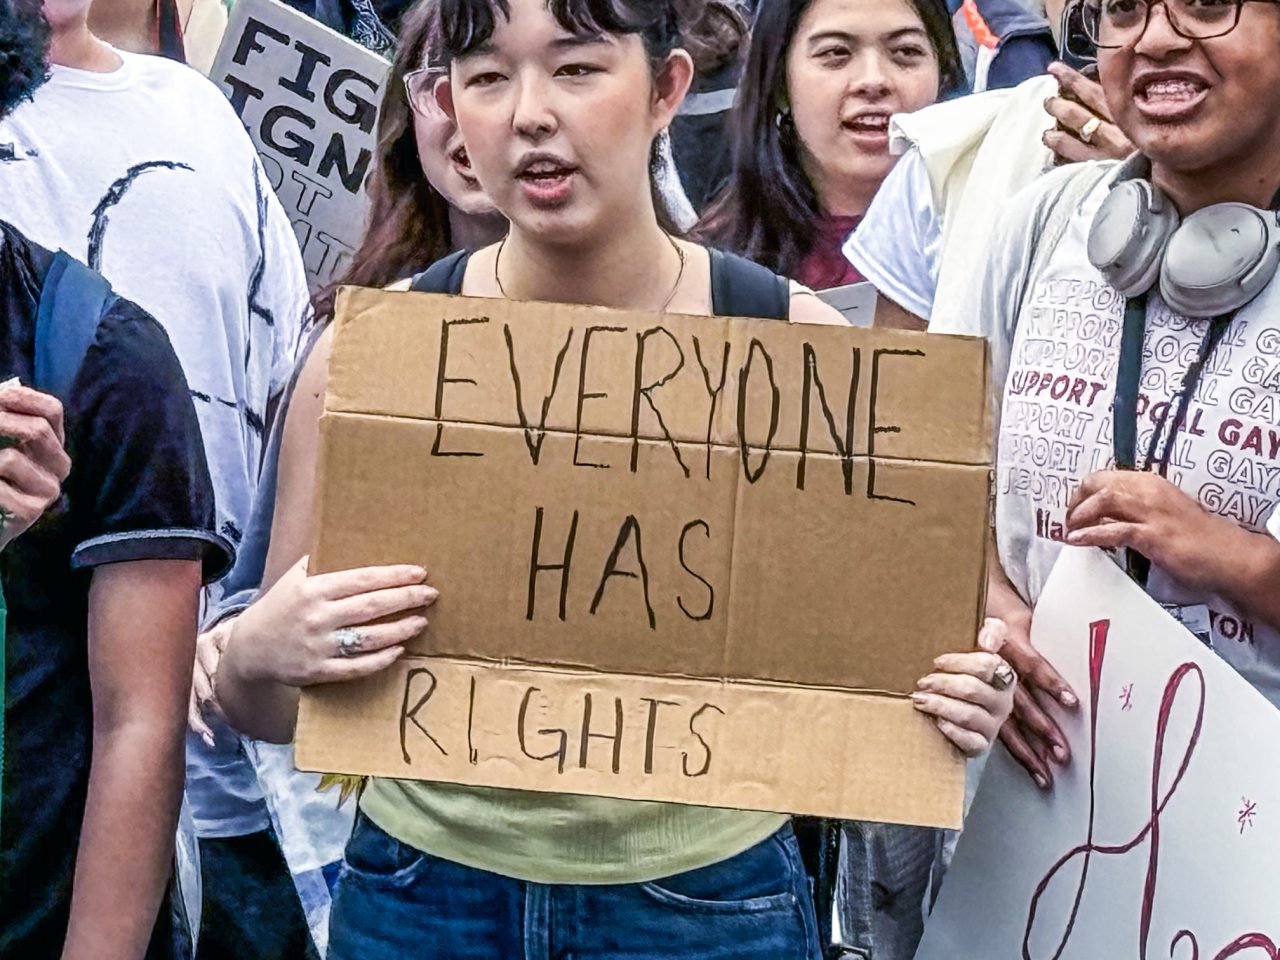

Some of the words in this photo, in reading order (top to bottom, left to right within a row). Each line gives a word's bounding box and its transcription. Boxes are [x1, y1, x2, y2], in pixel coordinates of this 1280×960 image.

[430, 316, 926, 507] EVERYONE
[1198, 482, 1272, 527] GAY
[525, 506, 716, 631] HAS
[399, 666, 725, 778] RIGHTS
